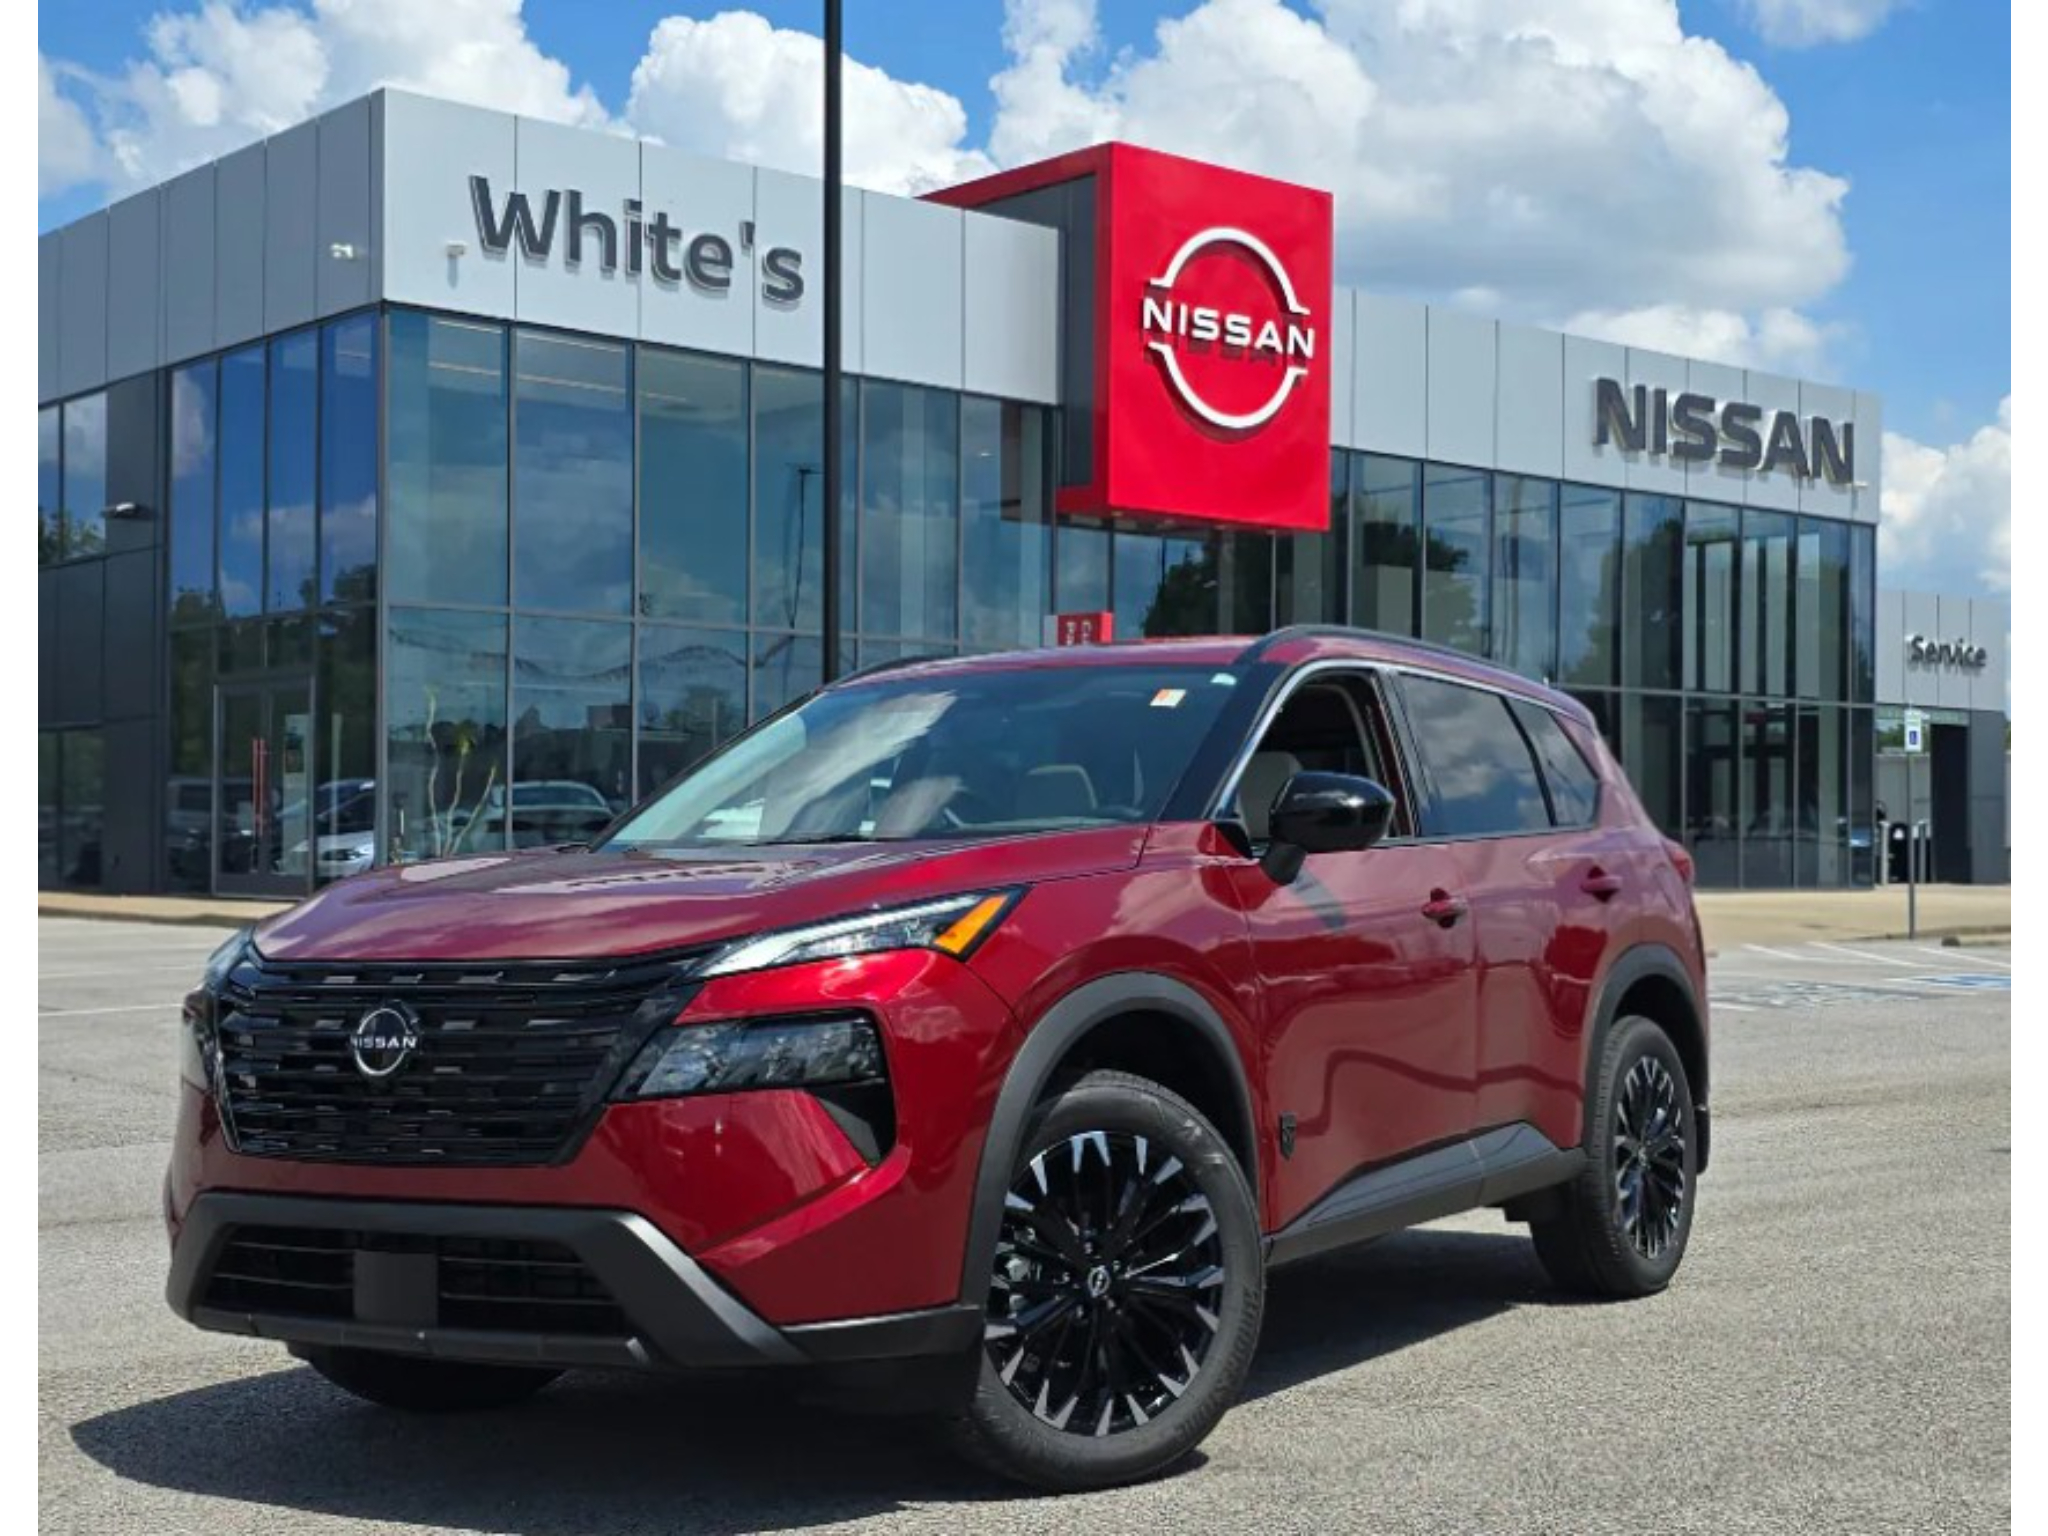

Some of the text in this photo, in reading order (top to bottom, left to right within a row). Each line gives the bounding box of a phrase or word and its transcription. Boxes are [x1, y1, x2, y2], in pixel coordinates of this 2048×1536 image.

[469, 175, 805, 303] White's
[1143, 297, 1315, 359] NISSAN
[1593, 377, 1855, 485] NISSAN
[1909, 635, 1987, 668] Service
[350, 1035, 418, 1050] NISSAN
